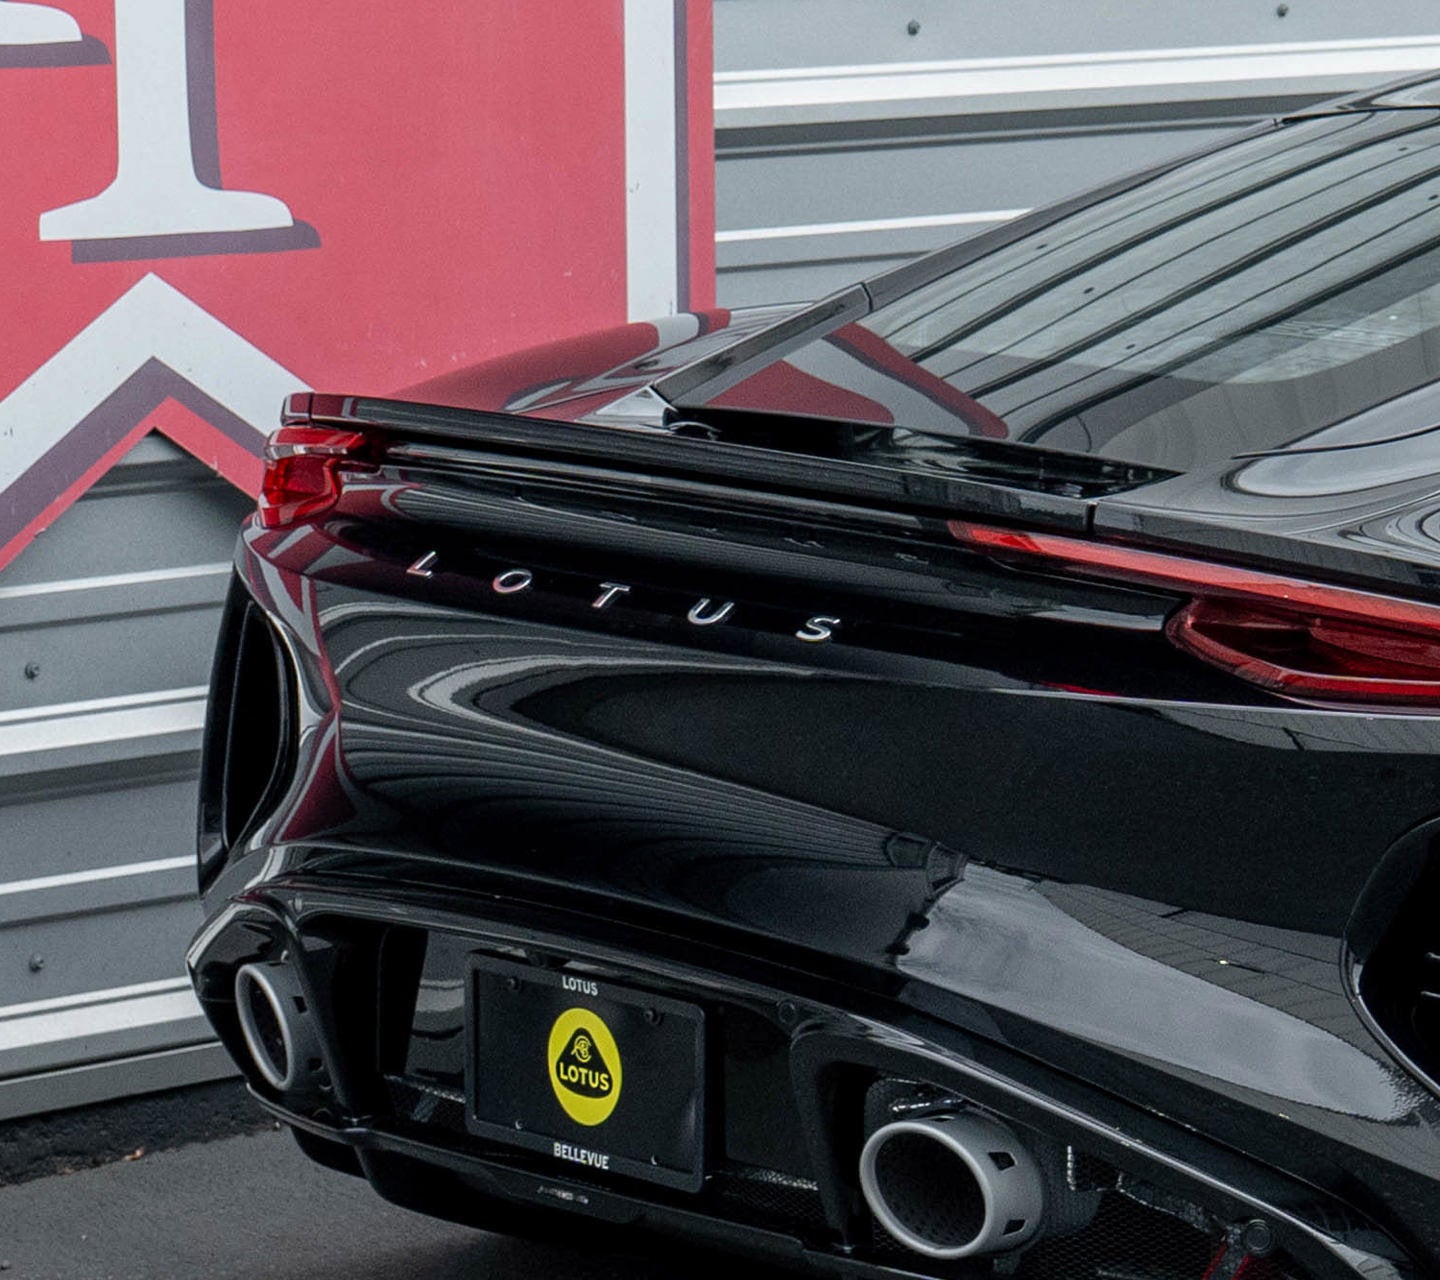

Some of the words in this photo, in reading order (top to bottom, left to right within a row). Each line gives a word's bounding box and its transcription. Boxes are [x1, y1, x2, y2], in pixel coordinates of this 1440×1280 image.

[407, 550, 841, 642] LOTUS
[562, 976, 598, 996] LOTUS
[559, 1062, 610, 1091] LOTUS
[553, 1142, 609, 1169] BELLEVUE
